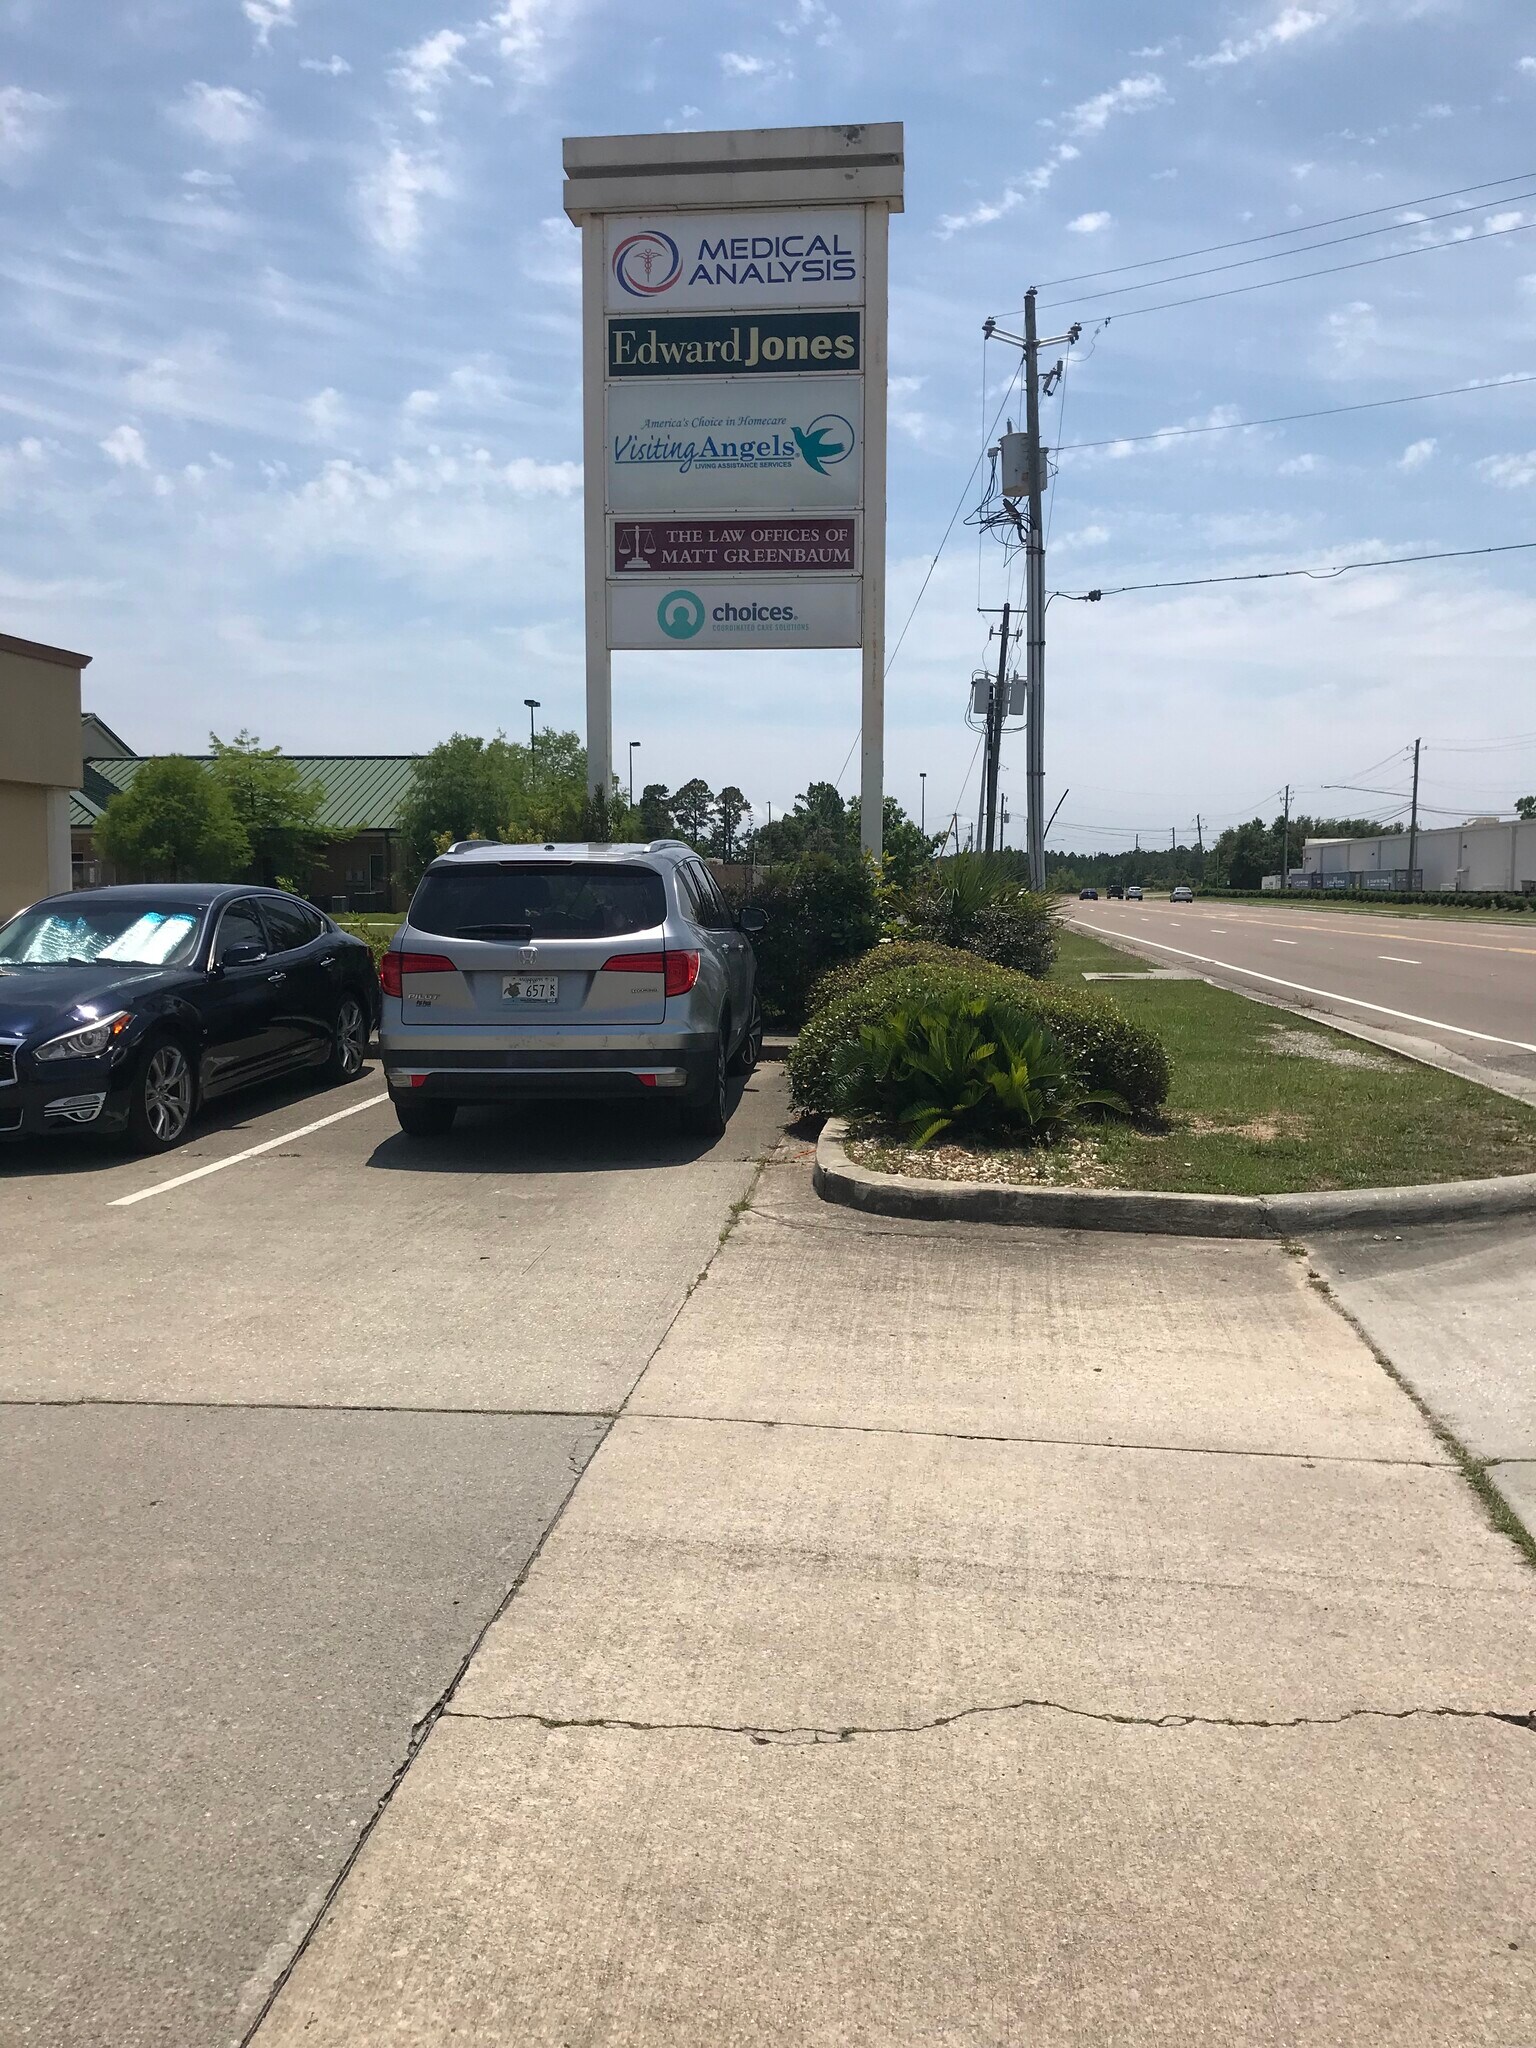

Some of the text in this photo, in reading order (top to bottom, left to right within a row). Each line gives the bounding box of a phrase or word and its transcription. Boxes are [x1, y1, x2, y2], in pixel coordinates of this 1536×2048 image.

[698, 234, 852, 260] MEDICAL
[688, 258, 856, 285] ANALYSIS
[641, 415, 787, 430] America's Choice in Homecare
[717, 461, 758, 469] ASSISTANCE
[667, 528, 848, 544] THE LAW OFFICES OF
[661, 548, 850, 564] MATT GREENBAUM
[712, 623, 810, 632] COORDINATED CARE SOLUTIONS
[526, 984, 546, 997] 657
